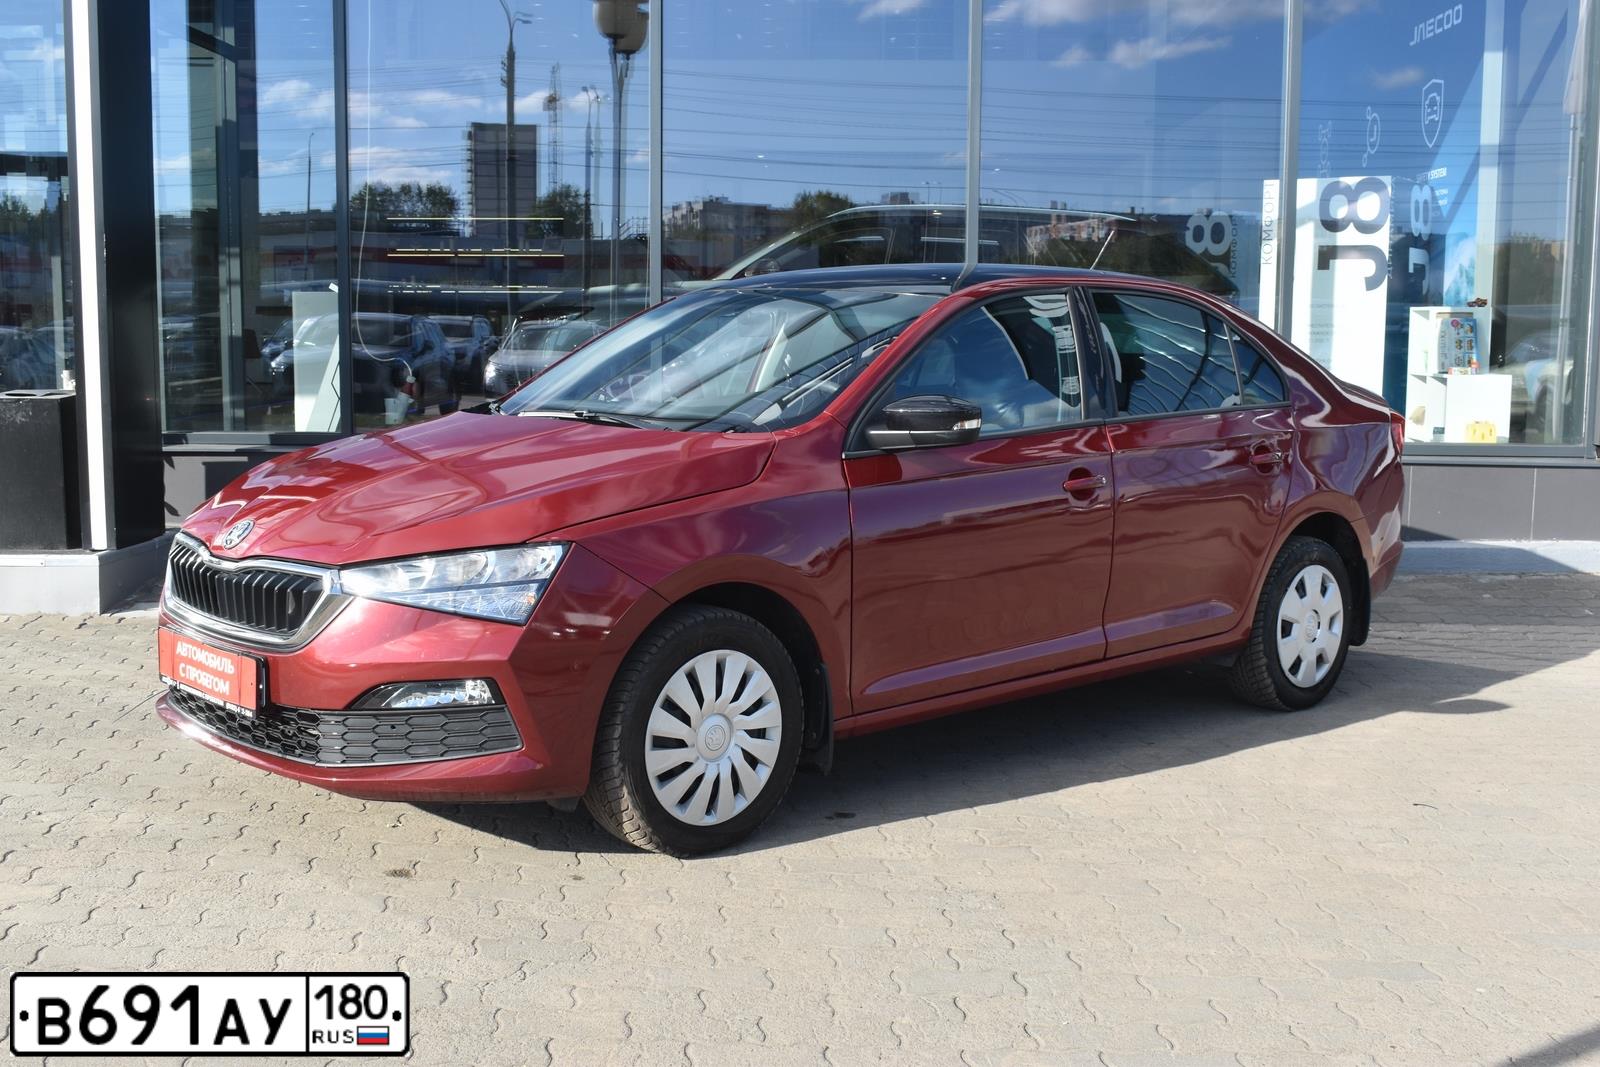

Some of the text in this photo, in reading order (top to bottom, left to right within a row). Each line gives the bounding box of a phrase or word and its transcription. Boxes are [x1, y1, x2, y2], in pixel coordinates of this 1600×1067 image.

[1317, 177, 1391, 292] J8
[175, 641, 235, 675] АВТОМОБИЛЬ
[178, 662, 186, 678] С
[185, 664, 230, 696] ПРОБЕГОМ
